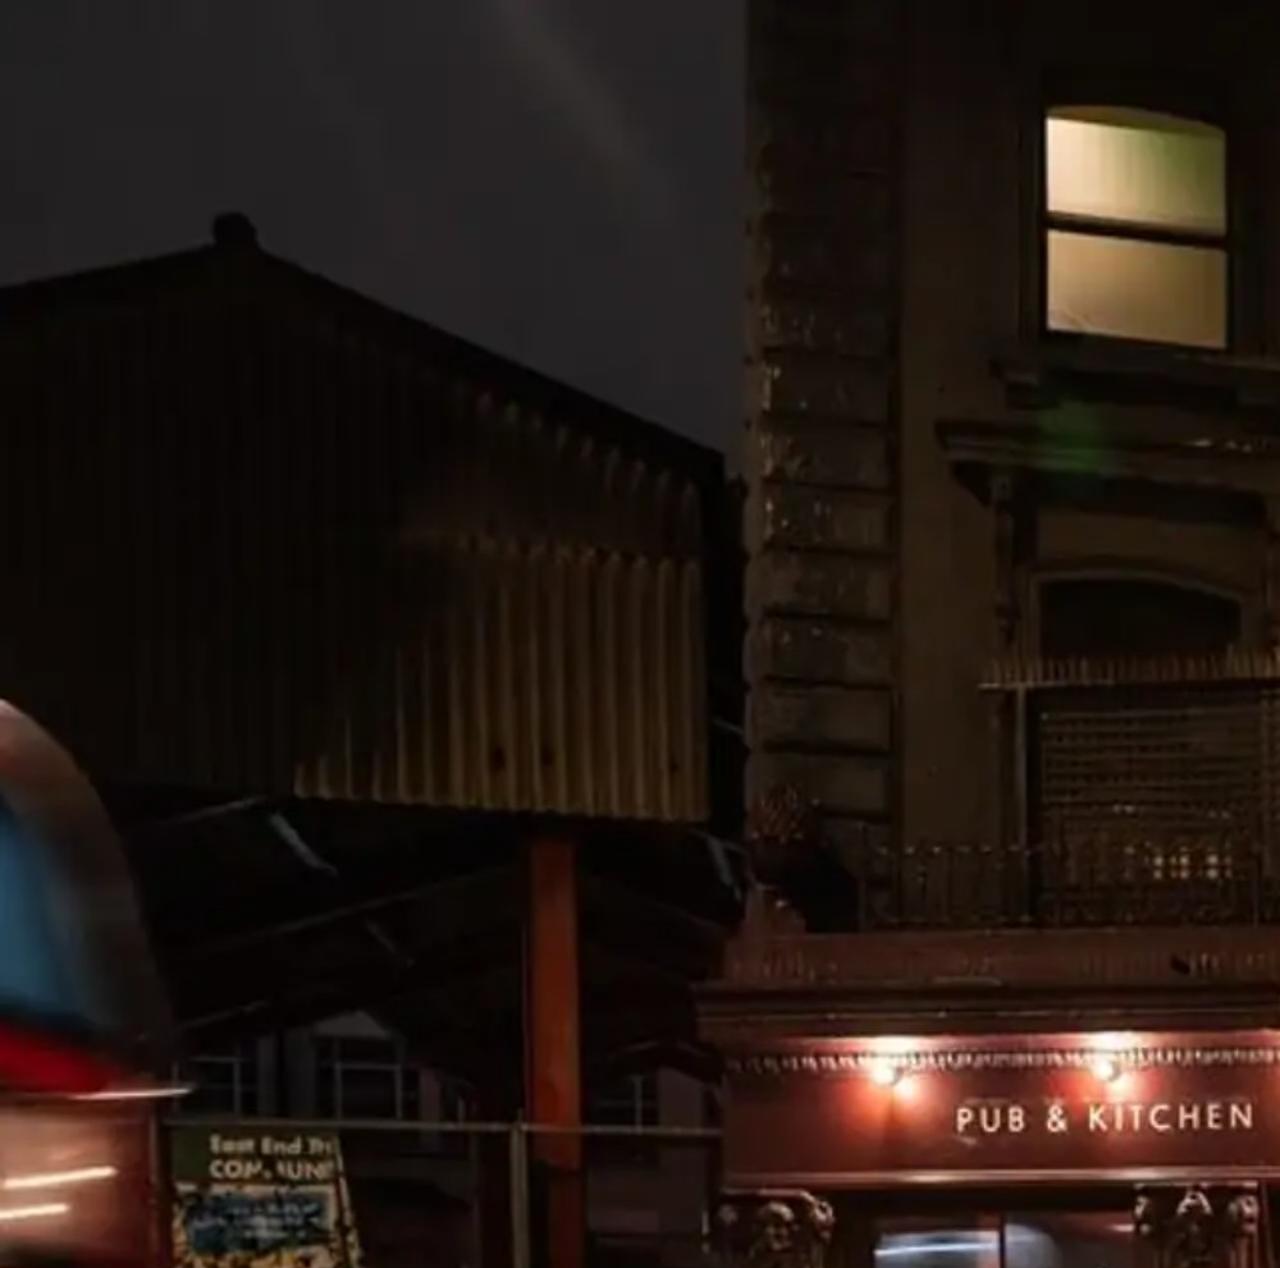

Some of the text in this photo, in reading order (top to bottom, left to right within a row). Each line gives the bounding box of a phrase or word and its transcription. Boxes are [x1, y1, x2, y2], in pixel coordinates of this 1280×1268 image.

[956, 1103, 1255, 1133] PUB & KITCHEN
[260, 1137, 301, 1154] End
